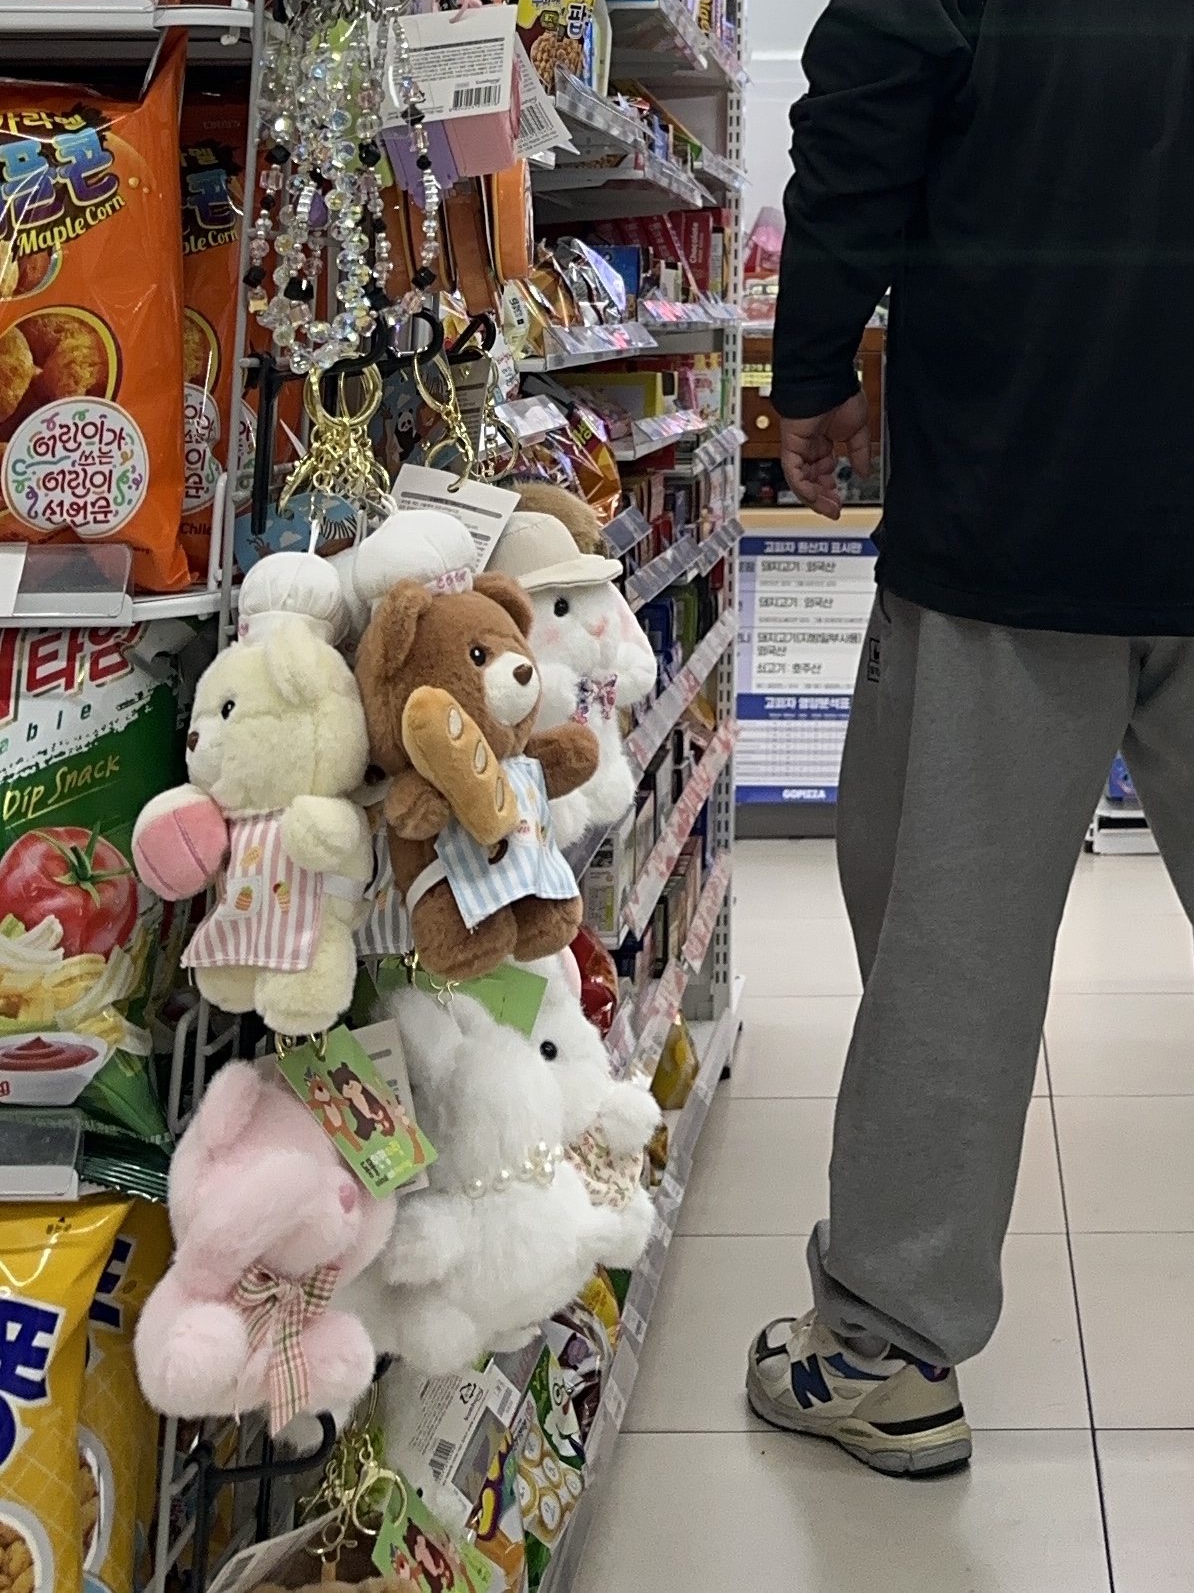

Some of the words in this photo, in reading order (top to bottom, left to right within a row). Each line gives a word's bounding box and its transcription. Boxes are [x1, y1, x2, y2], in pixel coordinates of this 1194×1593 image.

[0, 127, 119, 229] 플콘
[16, 218, 86, 257] Maple
[85, 195, 126, 226] Corn
[208, 229, 239, 251] Corn
[42, 467, 113, 499] 어린이
[2, 785, 45, 821] Dip
[48, 754, 120, 804] Snack
